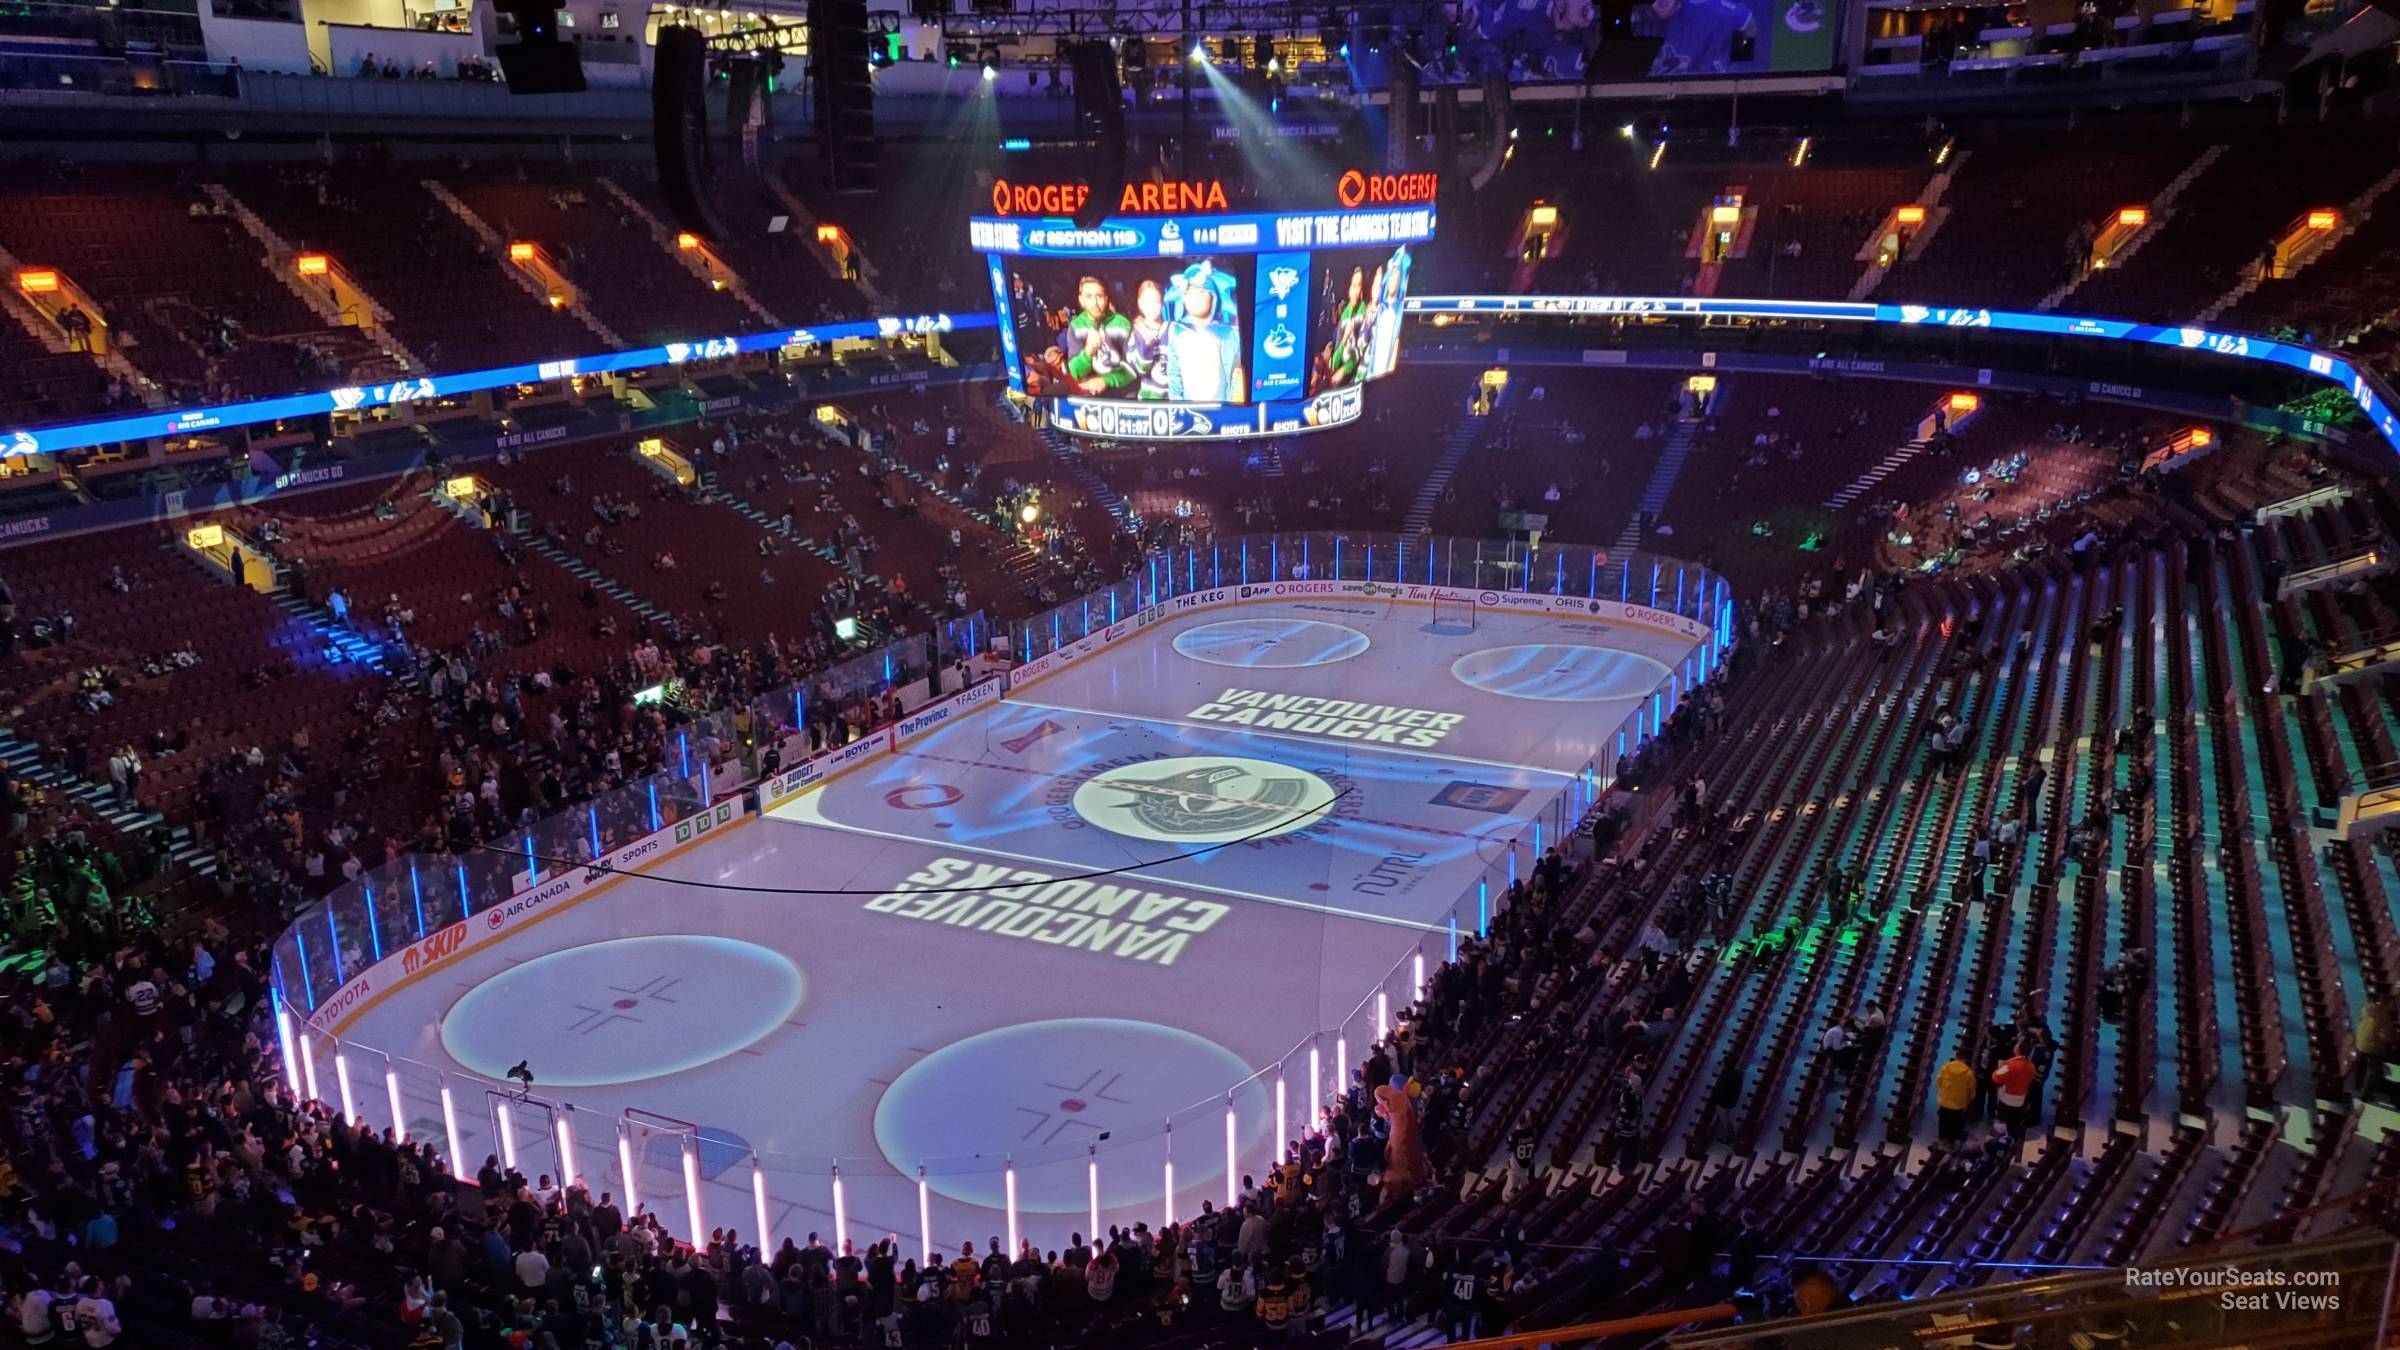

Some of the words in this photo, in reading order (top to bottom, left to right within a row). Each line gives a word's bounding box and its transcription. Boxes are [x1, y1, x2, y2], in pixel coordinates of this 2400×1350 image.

[1120, 181, 1228, 211] ARENA
[1370, 174, 1430, 202] ROGERS
[1277, 217, 1313, 246] VISIT
[1315, 216, 1339, 244] THE
[1341, 212, 1390, 243] CANUCKS
[191, 417, 220, 428] CANADA
[1101, 407, 1115, 434] 0
[1153, 409, 1169, 436] 0
[536, 426, 567, 442] CANUCKS
[275, 475, 288, 489] GO
[289, 468, 329, 486] CANUCKS
[331, 465, 343, 479] GO
[1176, 593, 1197, 609] THE
[1202, 591, 1225, 606] KEG
[1289, 583, 1334, 594] ROGERS
[1408, 586, 1427, 600] Tim
[1502, 595, 1544, 606] Supreme
[1555, 598, 1585, 609] ORIS
[1638, 611, 1676, 628] ROGERS
[1022, 658, 1050, 680] ROGERS
[960, 682, 995, 706] FASKEN
[900, 722, 915, 737] The
[915, 706, 949, 732] Province
[1216, 688, 1466, 731] VANCOUVER
[1186, 703, 1448, 747] CANUCKS
[845, 740, 870, 759] BOYD
[787, 763, 814, 785] BUDGET
[622, 839, 658, 863] SPORTS
[506, 903, 524, 919] AIR
[525, 880, 571, 910] CANADA
[906, 857, 1231, 933] CANUCKS
[863, 882, 1191, 966] VANCOUVER
[422, 922, 467, 966] SKIP
[136, 987, 154, 1002] 22
[324, 979, 370, 1024] TOYOTA
[1515, 1143, 1535, 1160] 87
[1453, 1280, 1474, 1300] 40
[972, 1318, 991, 1337] 40
